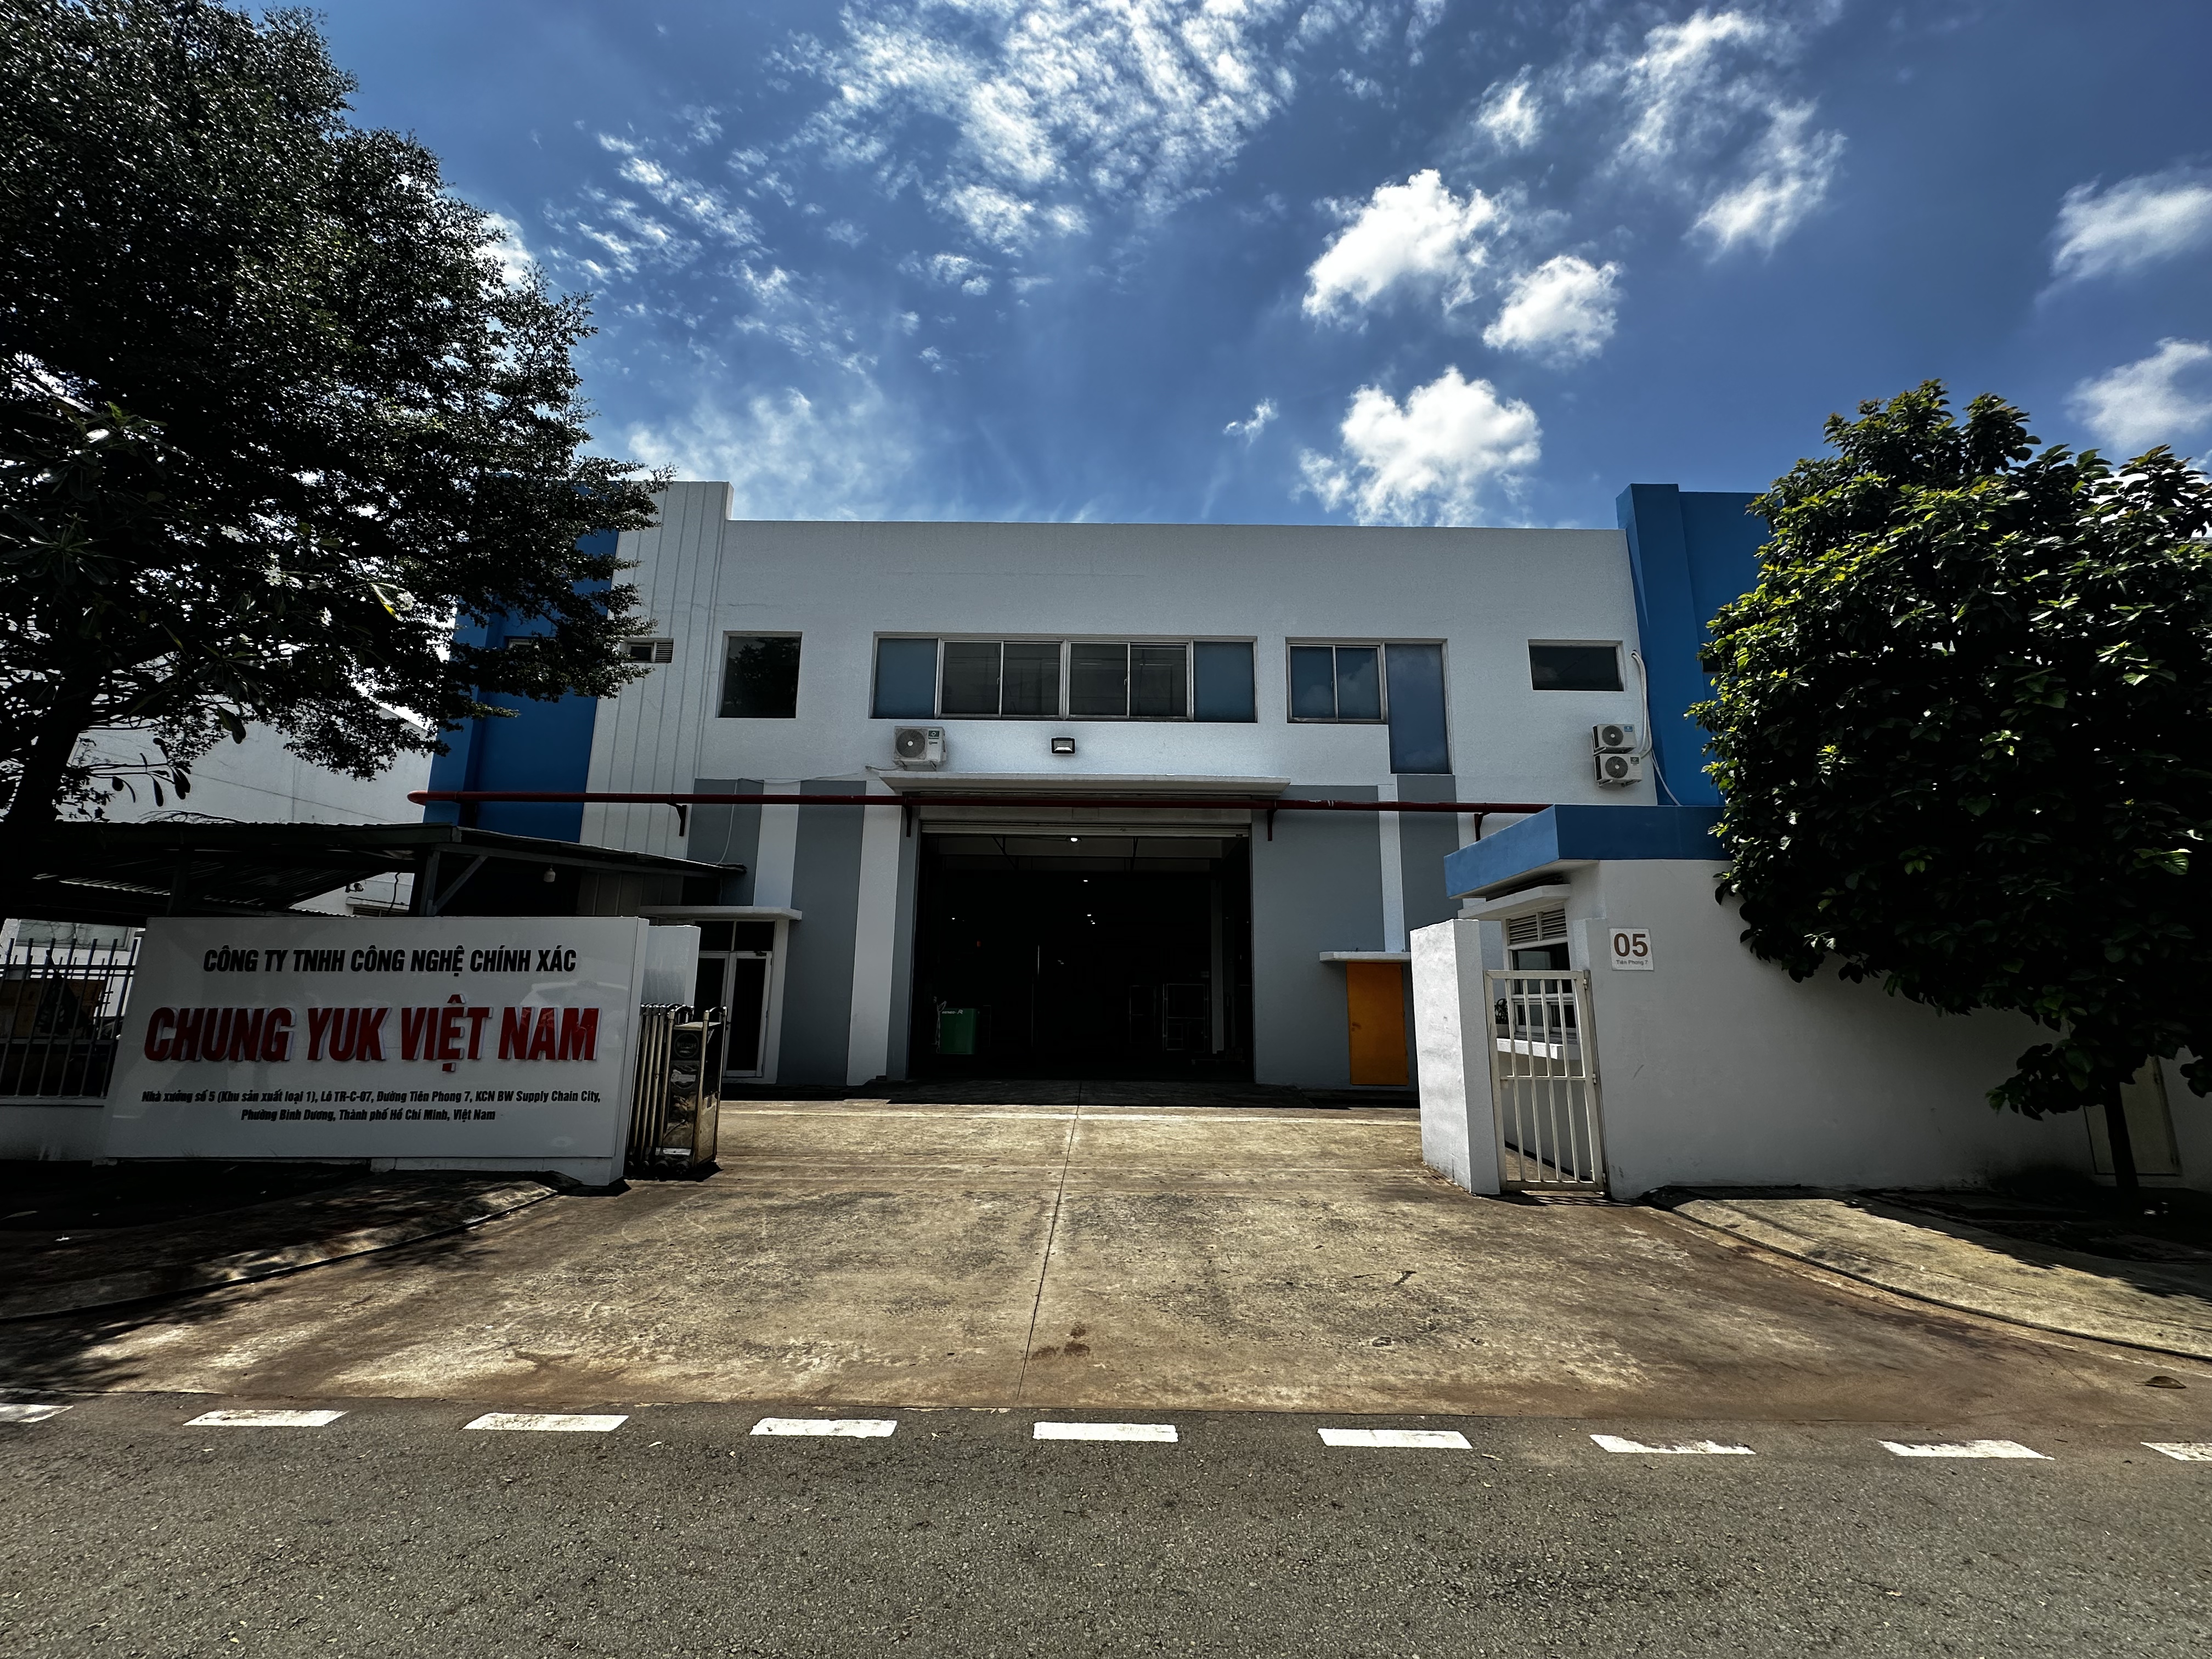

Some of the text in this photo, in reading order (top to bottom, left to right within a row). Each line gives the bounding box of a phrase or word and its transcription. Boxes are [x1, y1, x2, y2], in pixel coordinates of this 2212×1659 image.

[1613, 933, 1649, 957] 05
[204, 945, 577, 977] CÔNG TY TNHH CÔNG NGHỆ CHÍNH XÁC
[144, 994, 602, 1072] CHUNG YUK VIỆT NAM
[208, 1091, 216, 1102] 5
[218, 1091, 240, 1103] (Khu
[241, 1090, 259, 1102] sản
[261, 1089, 283, 1102] xuất
[284, 1091, 304, 1104] loại
[306, 1091, 318, 1103] 1),
[320, 1090, 332, 1102] Lô
[334, 1091, 375, 1103] TR-C-07,
[410, 1091, 429, 1102] Tiên
[431, 1091, 462, 1103] Phong
[464, 1091, 473, 1103] 7,
[475, 1090, 495, 1102] KCN
[497, 1091, 515, 1102] BW
[516, 1090, 549, 1103] Supply
[551, 1090, 579, 1102] Chain
[580, 1090, 601, 1103] City,
[303, 1109, 336, 1121] Dương,
[369, 1107, 390, 1121] phố
[405, 1108, 422, 1120] Chí
[423, 1109, 450, 1121] Minh,
[453, 1109, 472, 1122] Việt
[473, 1109, 496, 1120] Nam
